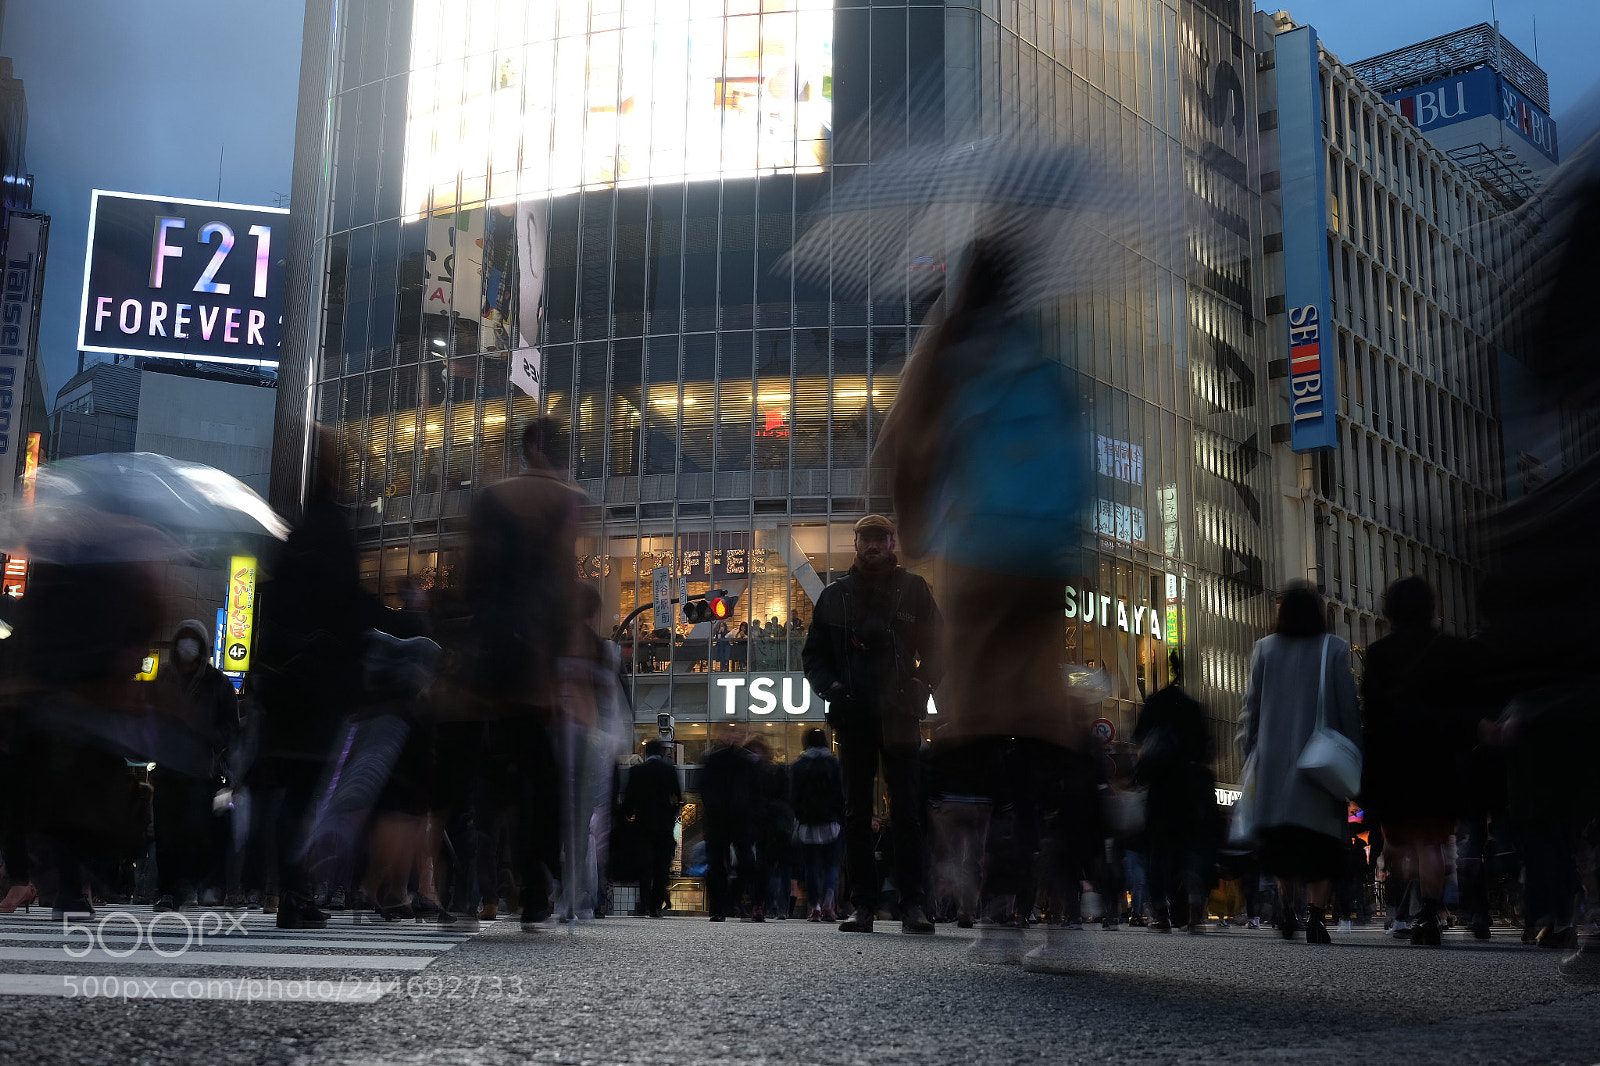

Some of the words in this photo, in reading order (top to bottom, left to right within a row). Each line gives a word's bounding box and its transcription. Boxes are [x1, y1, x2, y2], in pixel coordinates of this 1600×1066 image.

[1502, 86, 1553, 156] SEIBU
[148, 215, 271, 298] F21
[94, 296, 265, 346] FOREVER
[1289, 304, 1322, 423] SEIBU
[632, 548, 766, 577] COFFEE
[1065, 585, 1161, 640] SUTAYA
[229, 645, 246, 658] 4F
